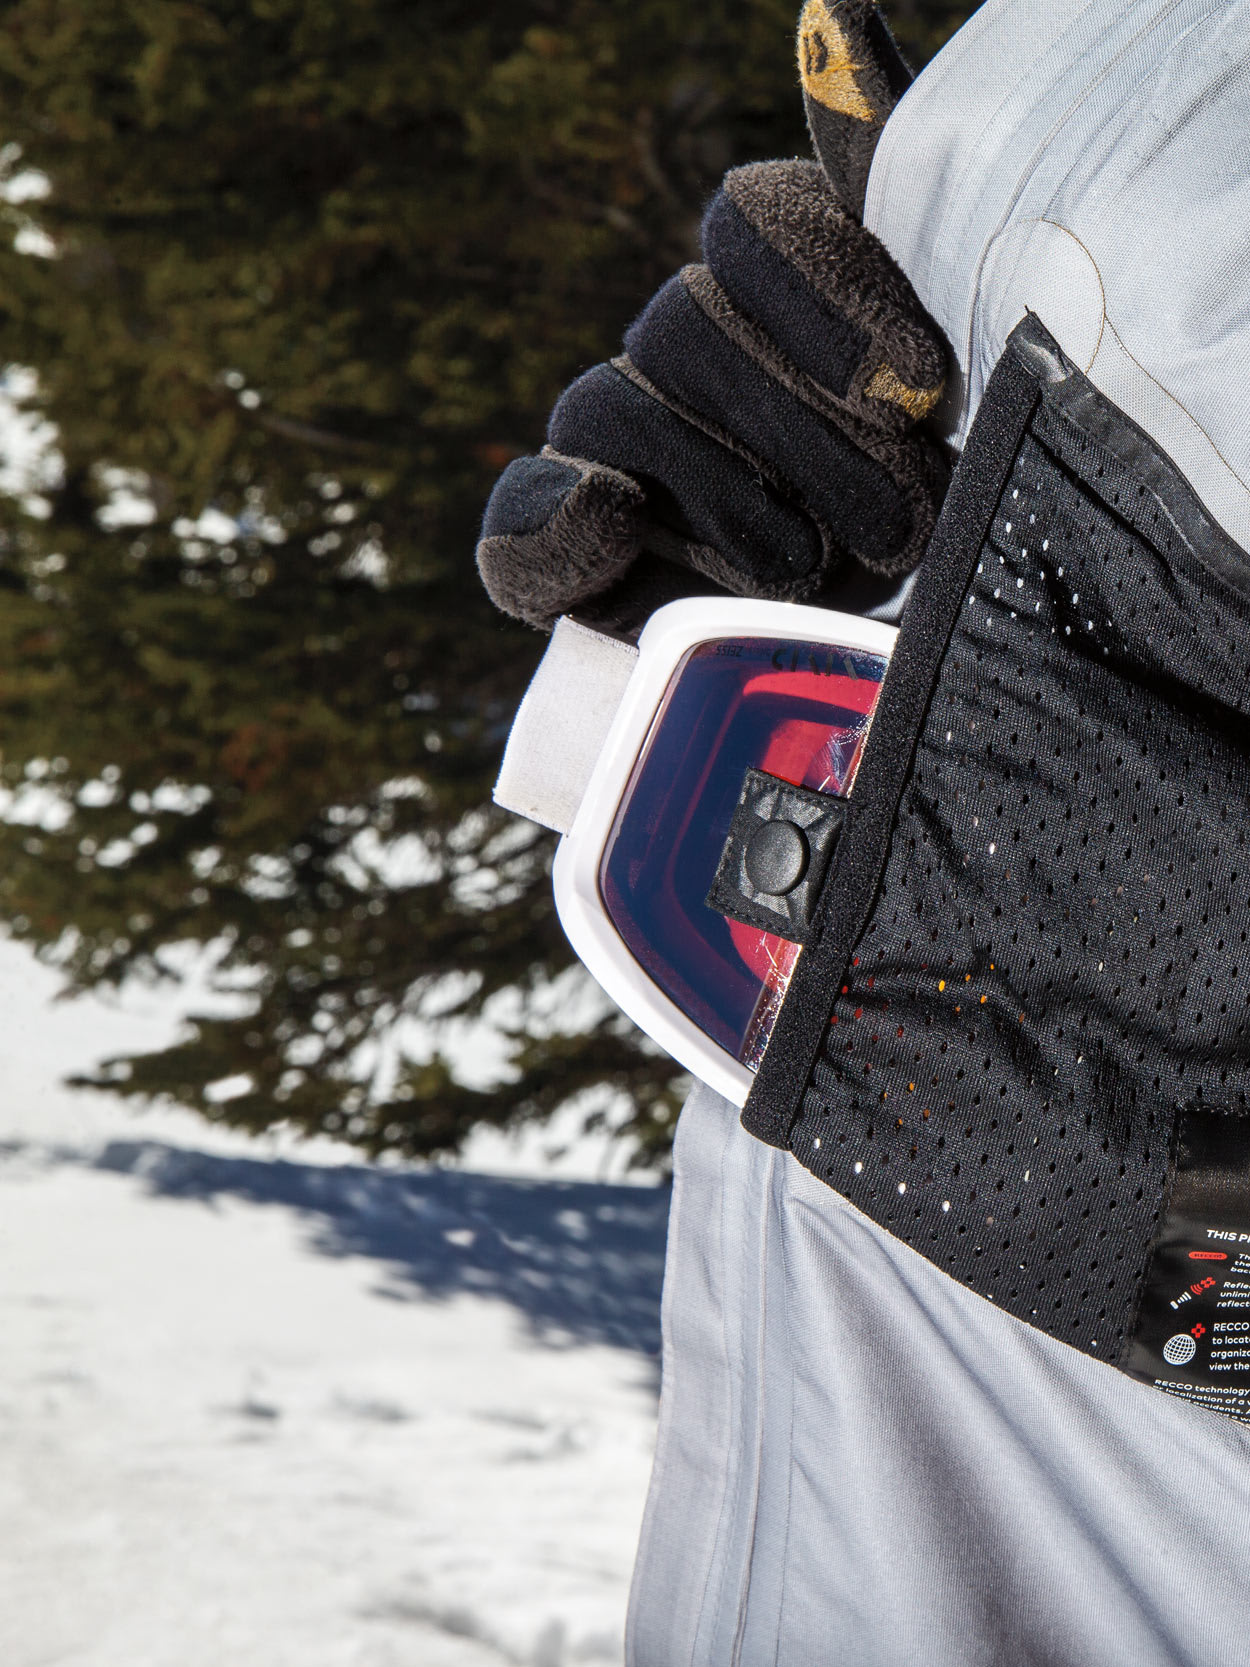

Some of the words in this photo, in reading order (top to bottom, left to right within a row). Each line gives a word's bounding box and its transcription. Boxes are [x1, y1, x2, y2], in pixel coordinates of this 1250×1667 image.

[717, 645, 744, 657] ZEISS
[1207, 1229, 1237, 1241] THIS
[1213, 1322, 1250, 1331] RECCO
[1212, 1337, 1222, 1345] to
[1209, 1362, 1232, 1371] view
[1234, 1361, 1250, 1370] the
[1154, 1379, 1192, 1391] RECCO
[1194, 1385, 1250, 1396] technology
[1165, 1387, 1223, 1404] localization
